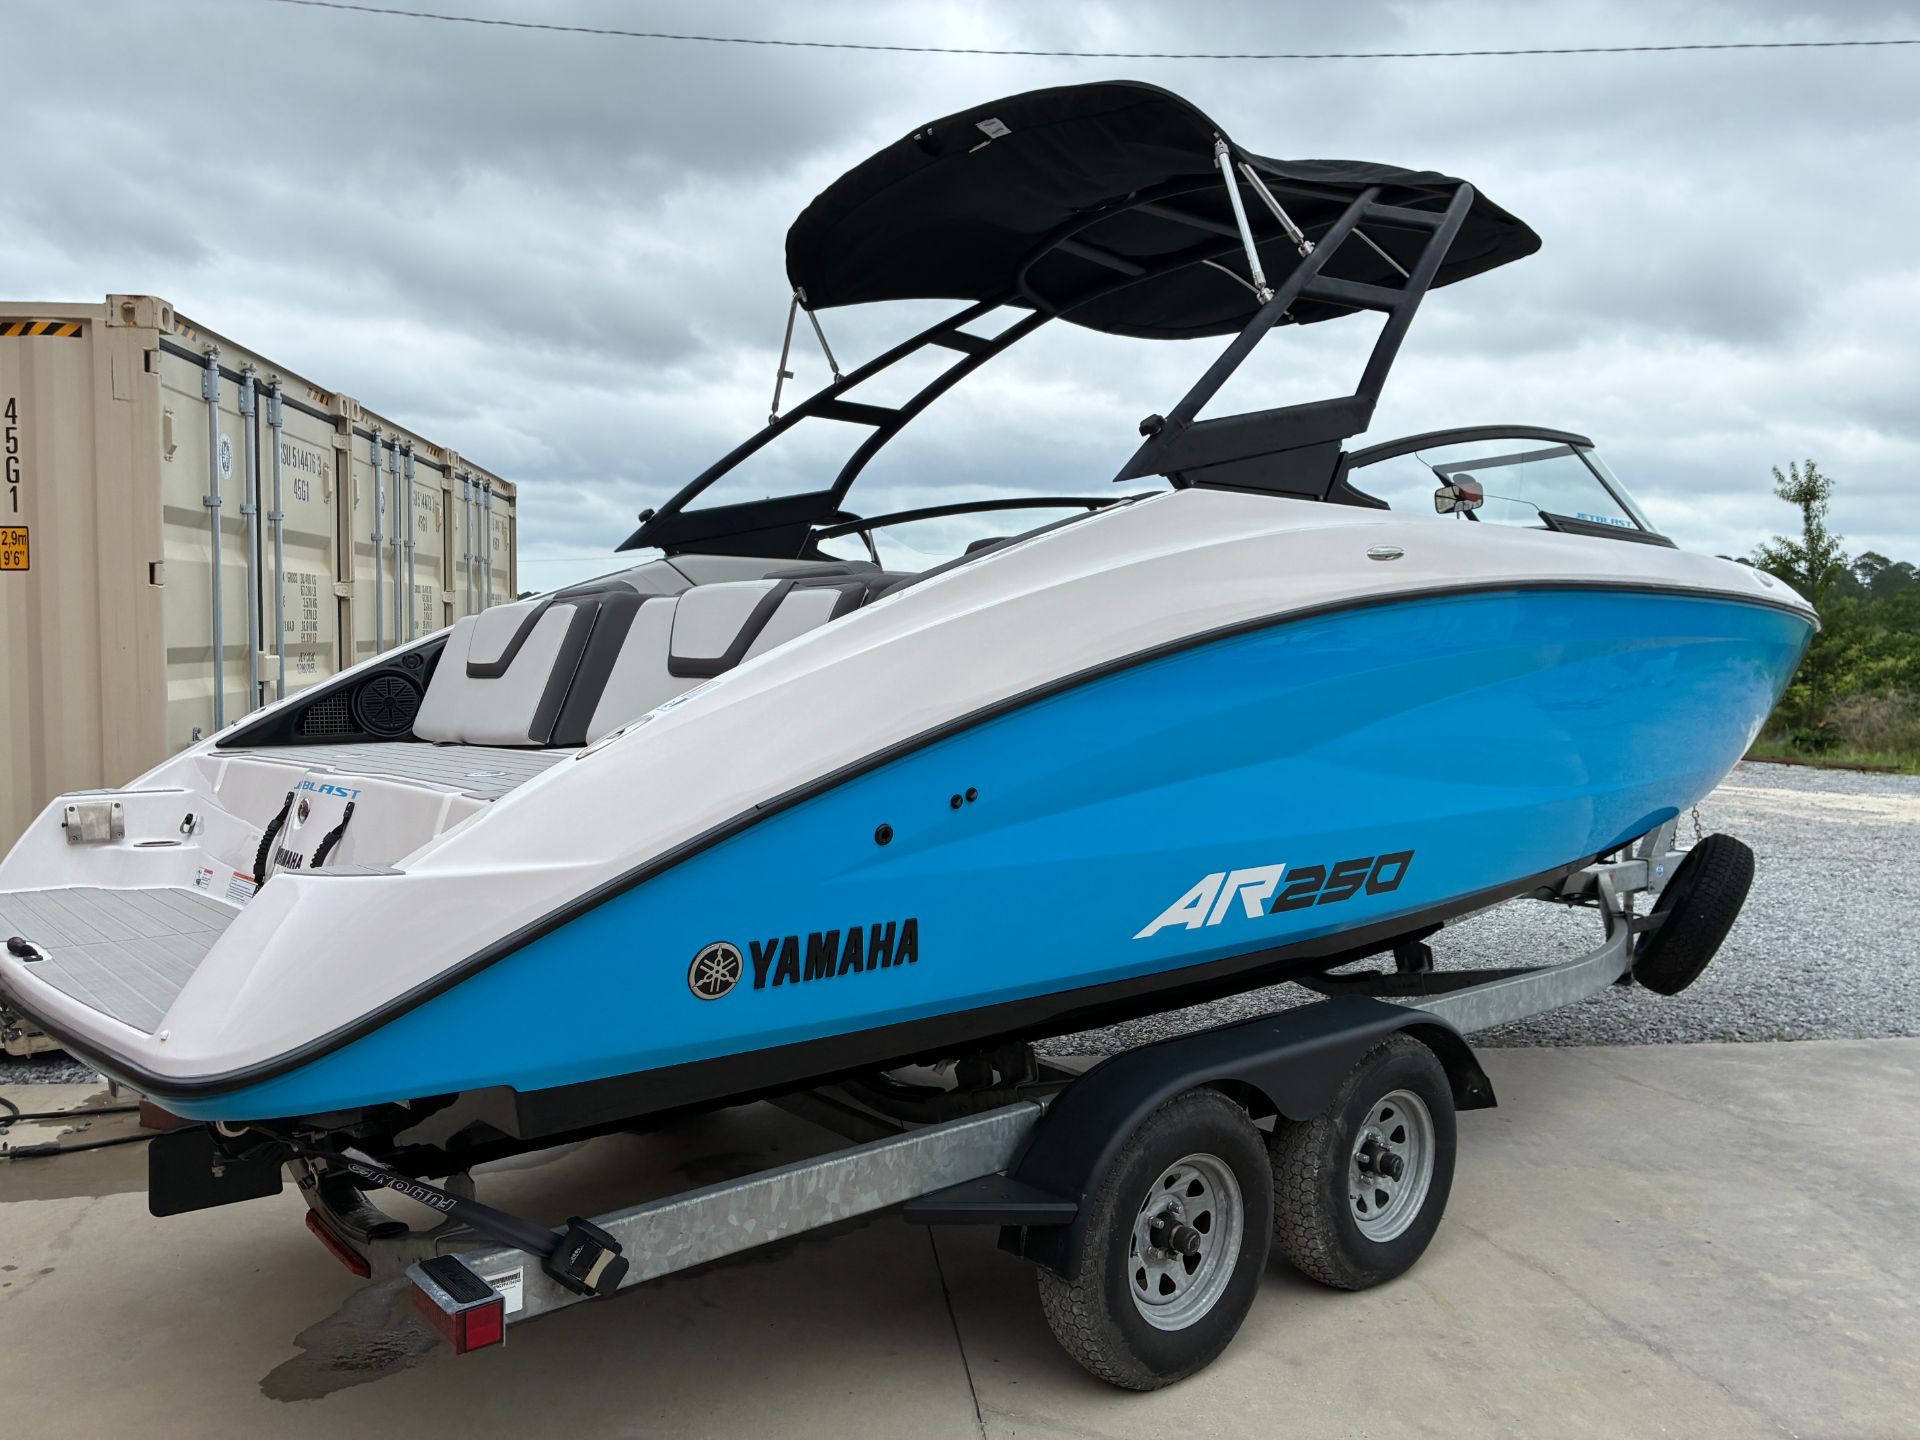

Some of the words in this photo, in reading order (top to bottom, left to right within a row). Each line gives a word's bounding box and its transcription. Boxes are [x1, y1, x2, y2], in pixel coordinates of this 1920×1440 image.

[4, 397, 20, 513] 45G1
[293, 478, 310, 502] 45G1
[1, 531, 27, 547] 2,9m
[3, 551, 25, 566] 9'6"
[1131, 849, 1416, 940] AR250
[749, 918, 919, 990] YAMAHA
[370, 1173, 458, 1212] FULTON
